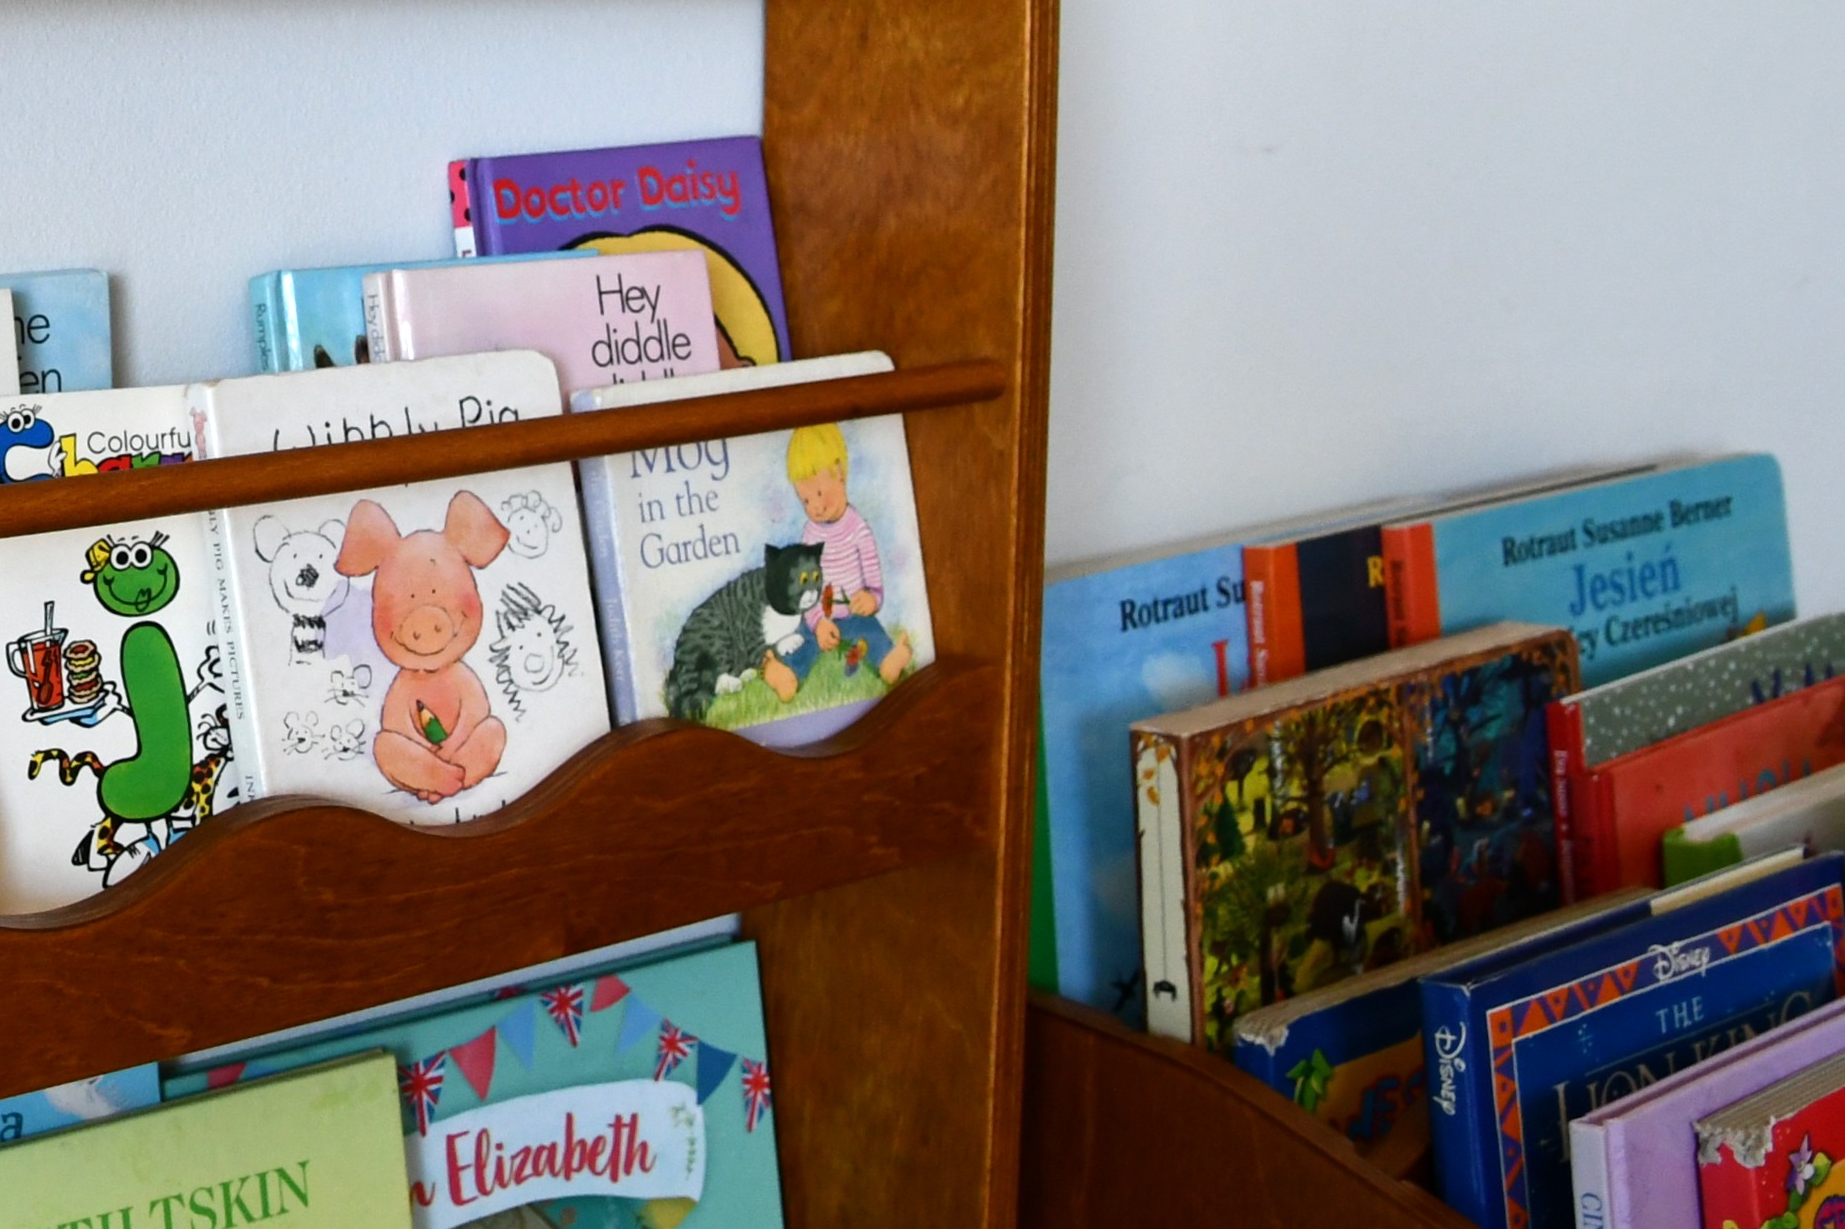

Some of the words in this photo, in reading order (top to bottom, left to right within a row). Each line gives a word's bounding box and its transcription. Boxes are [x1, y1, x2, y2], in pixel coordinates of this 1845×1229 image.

[492, 175, 624, 224] Doctor
[637, 164, 743, 221] Daisy
[596, 273, 661, 324] Hey
[592, 318, 692, 368] diddle
[18, 368, 63, 395] en
[638, 493, 665, 523] in
[675, 480, 719, 517] the
[640, 523, 741, 569] Garden
[1501, 528, 1576, 567] Rotraut
[1582, 510, 1664, 549] Susanne
[1669, 496, 1733, 528] Berner
[212, 543, 224, 571] PIG
[1569, 540, 1681, 618] Jesień
[216, 578, 233, 634] MAKES
[1120, 587, 1209, 633] Rotraut
[226, 641, 246, 720] PICTURES
[1655, 996, 1705, 1033] THE
[0, 1111, 25, 1143] a
[446, 1112, 656, 1206] Elizabeth
[57, 1160, 310, 1229] TSKIN
